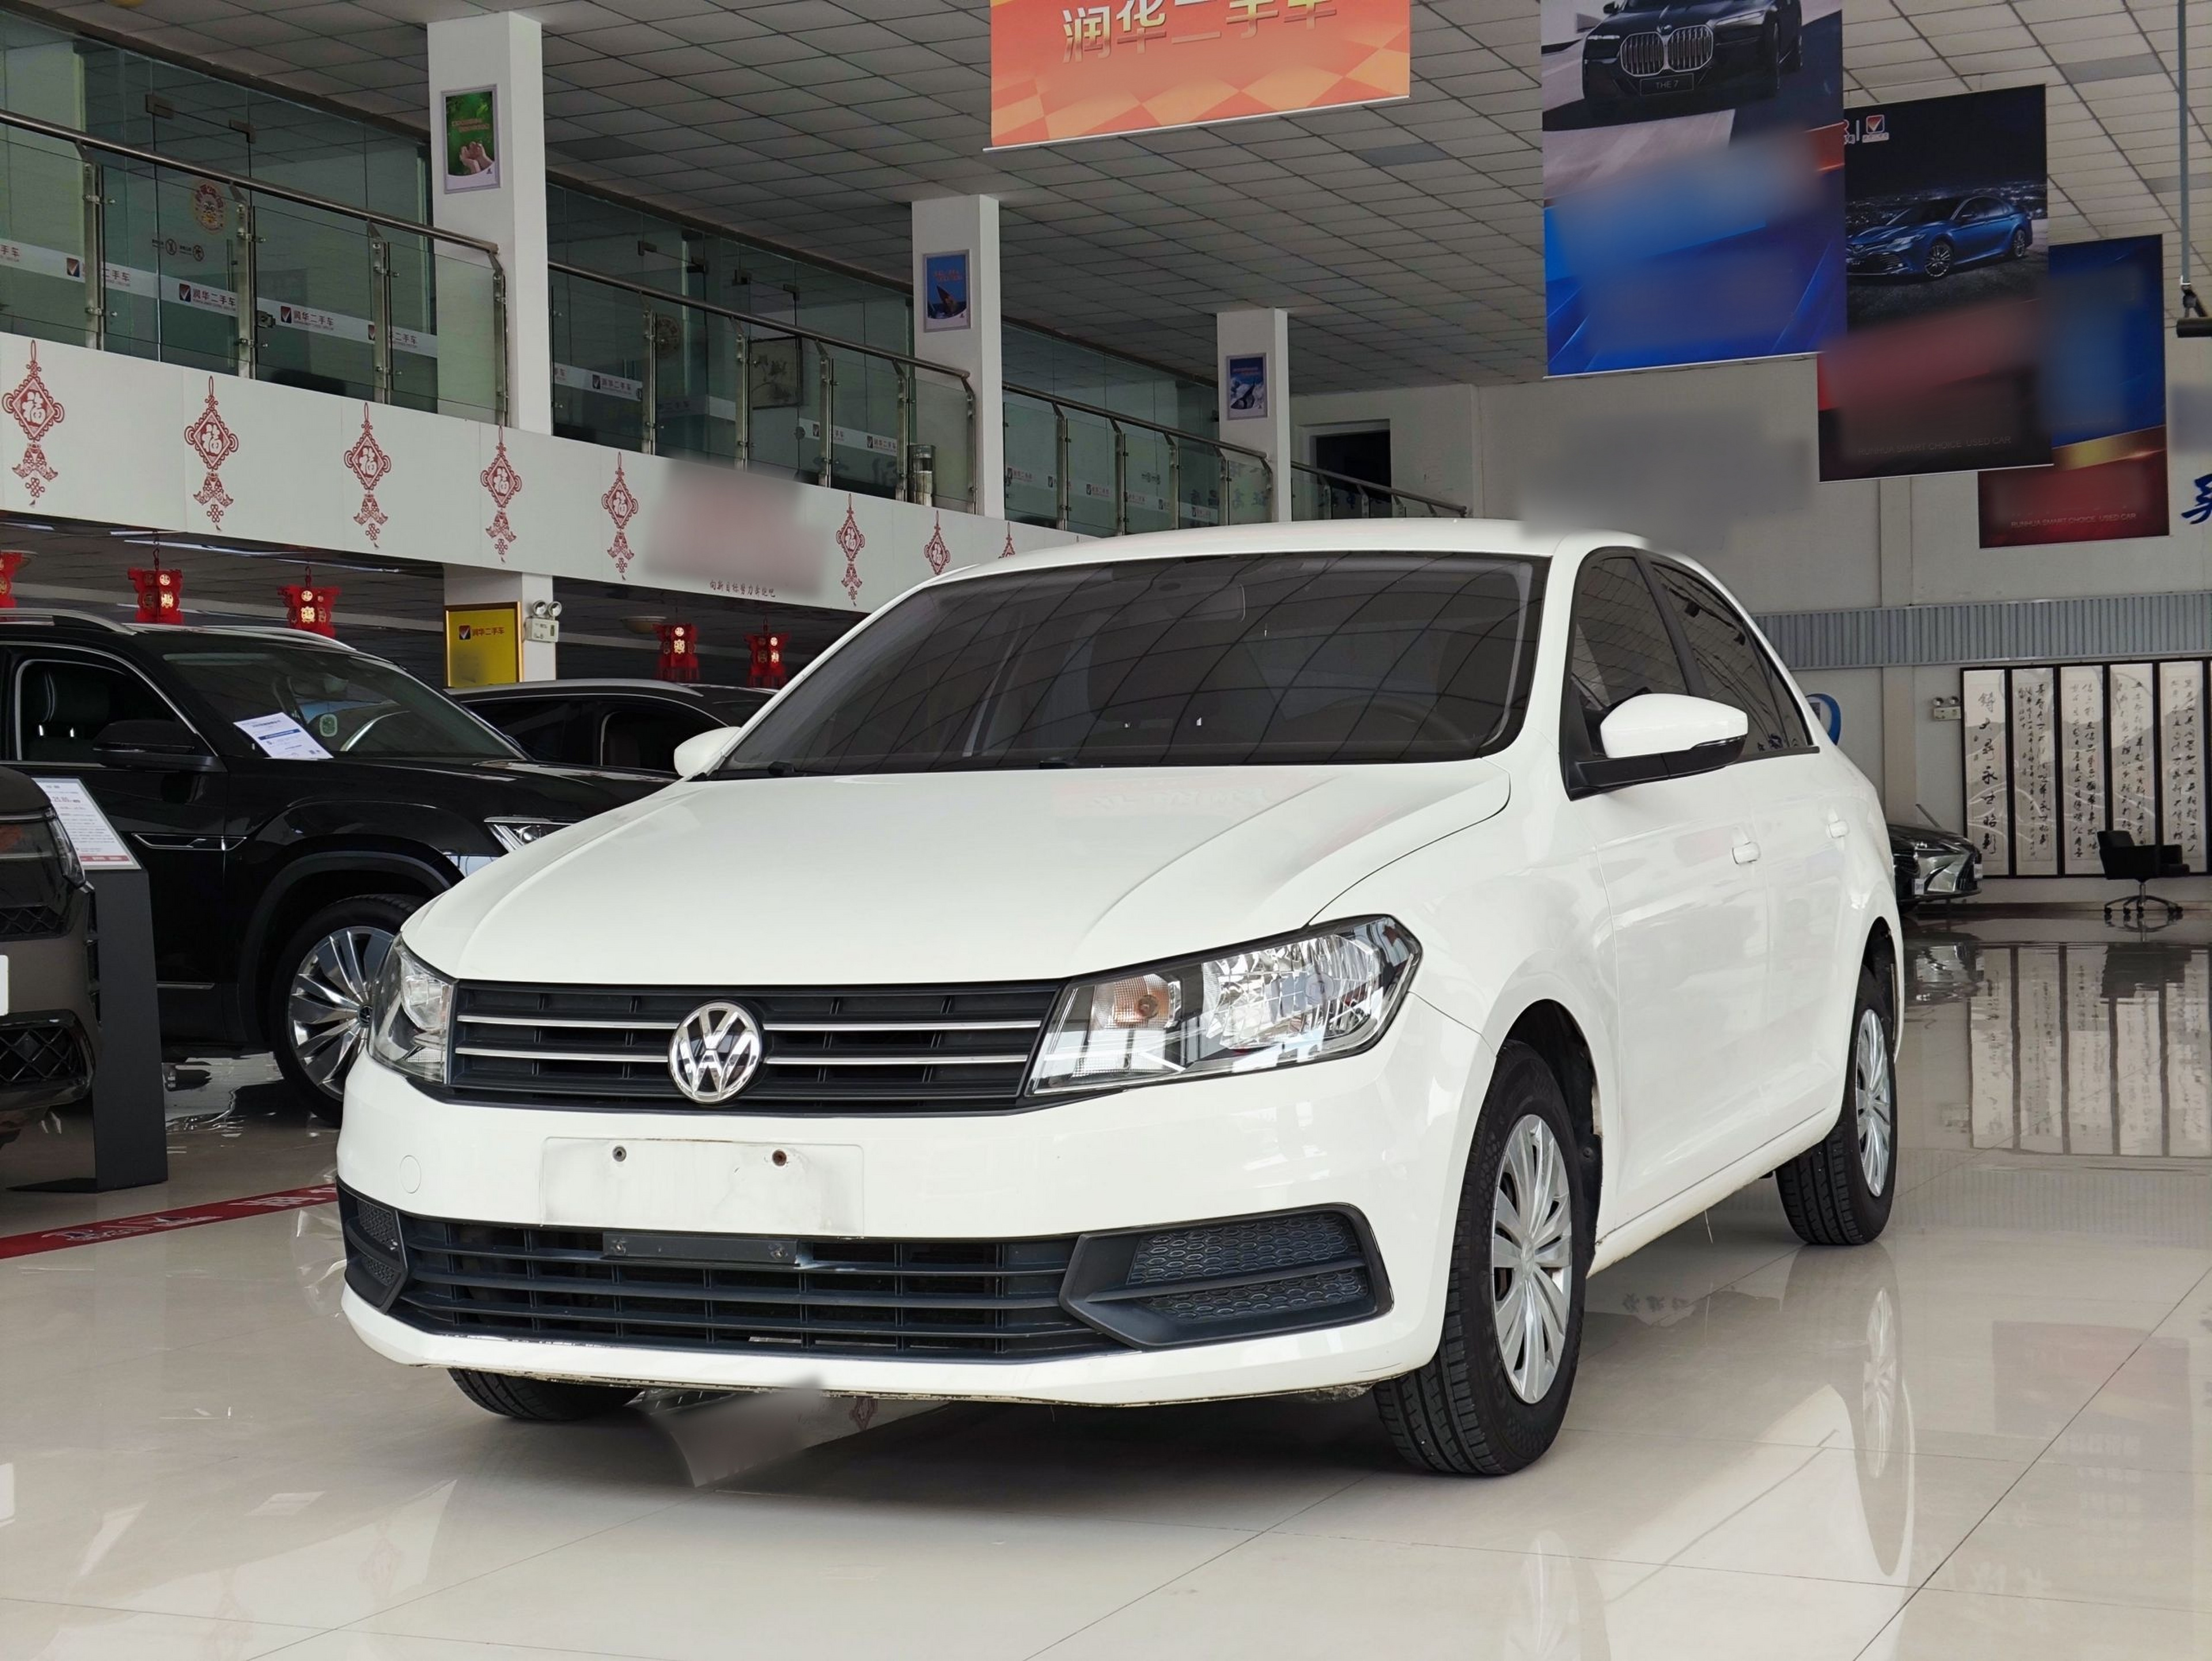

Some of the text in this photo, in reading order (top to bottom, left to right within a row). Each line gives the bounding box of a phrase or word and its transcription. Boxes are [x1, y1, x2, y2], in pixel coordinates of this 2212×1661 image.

[1062, 0, 1337, 63] 润华二手车
[1655, 80, 1679, 89] THE 7
[192, 289, 236, 307] 润华二手车
[293, 310, 334, 326] 润华二手车
[1896, 442, 1926, 453] SMART
[1928, 440, 1962, 451] CHOICE
[1966, 437, 1990, 447] USED
[1992, 436, 2012, 444] CAR
